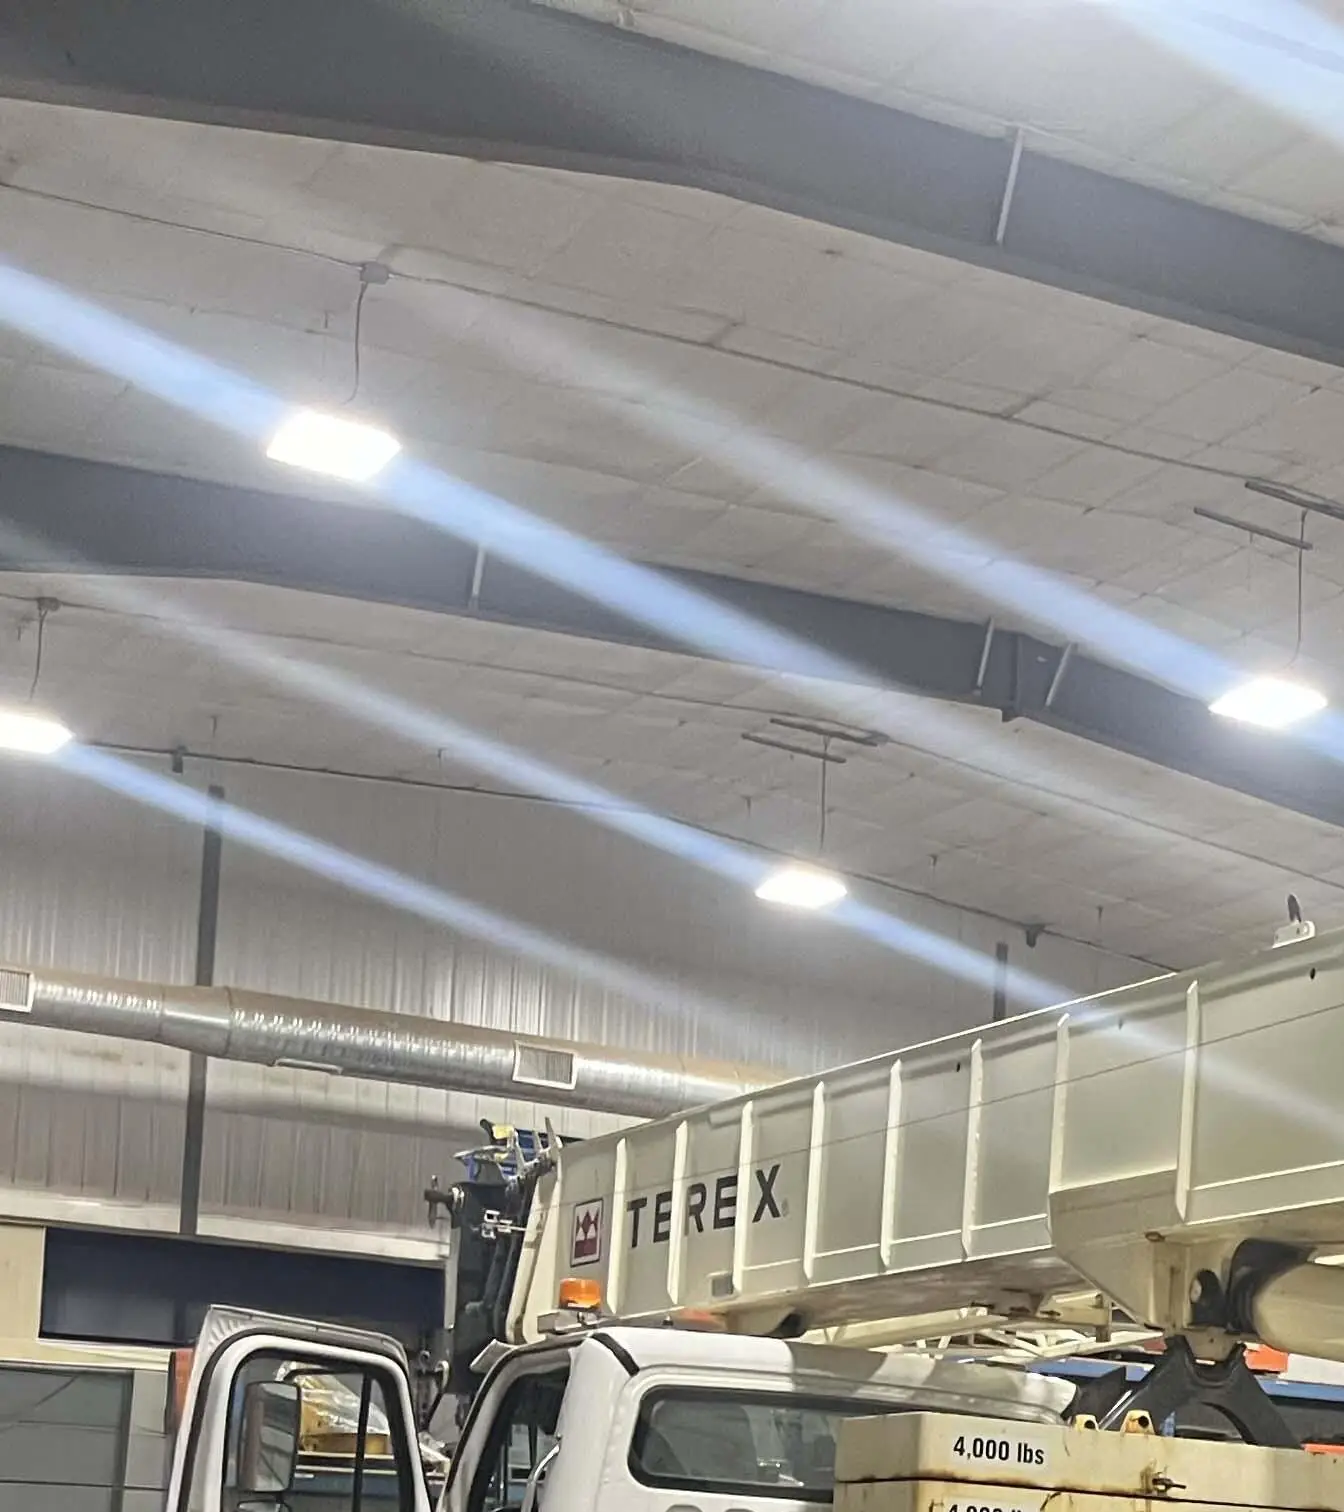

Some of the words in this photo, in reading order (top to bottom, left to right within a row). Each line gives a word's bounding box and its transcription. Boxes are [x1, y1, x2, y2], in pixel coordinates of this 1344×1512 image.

[627, 1164, 781, 1249] TEREX
[953, 1436, 1010, 1461] 4,000
[1017, 1442, 1045, 1465] lbs
